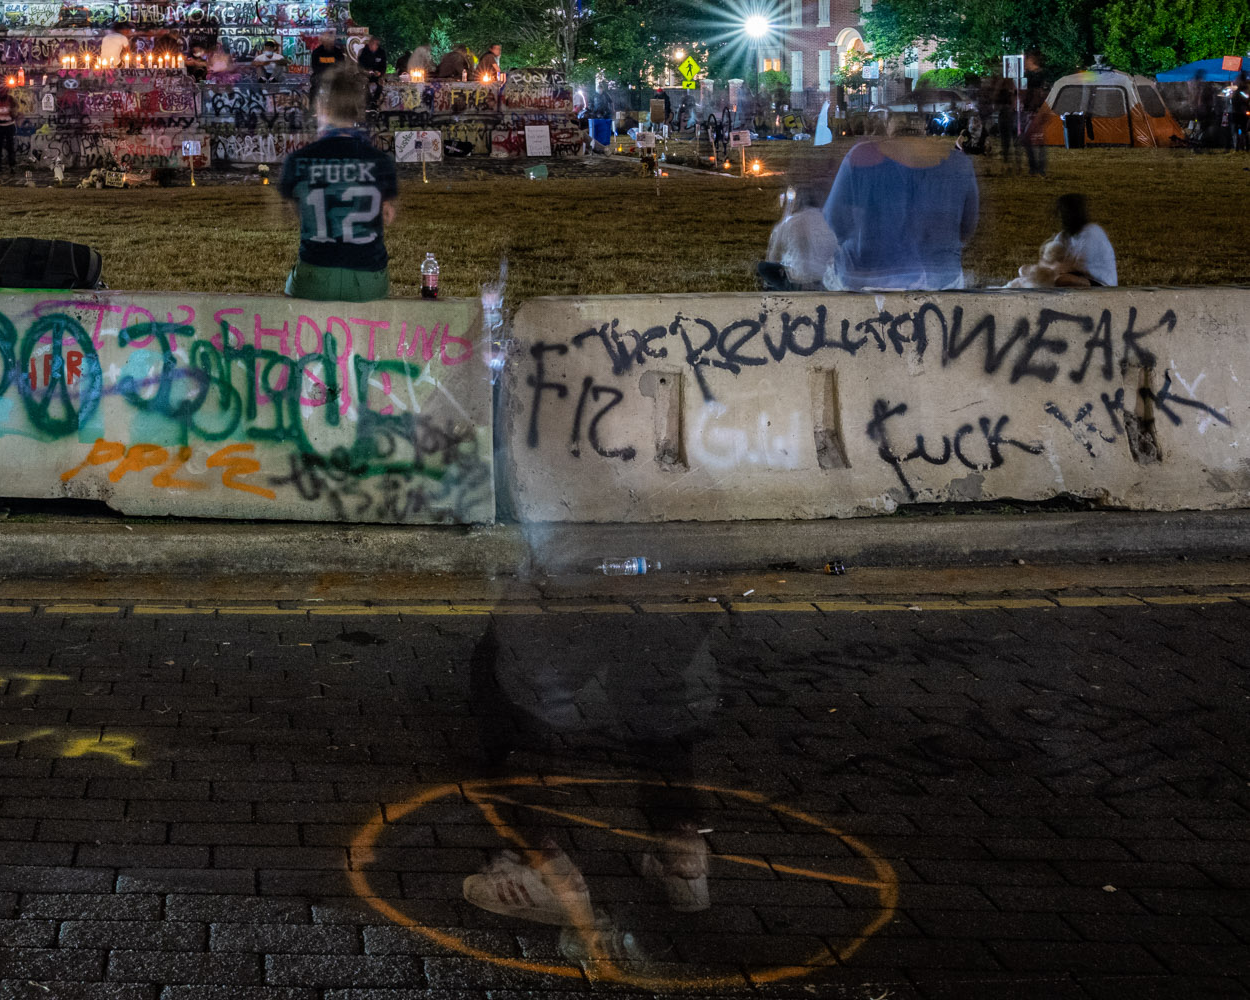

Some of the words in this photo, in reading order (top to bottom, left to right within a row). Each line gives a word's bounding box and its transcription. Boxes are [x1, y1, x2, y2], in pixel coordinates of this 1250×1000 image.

[511, 73, 549, 85] FUCK
[451, 88, 488, 106] FTP
[309, 162, 376, 185] FUCK
[306, 186, 382, 245] 12
[950, 305, 1177, 384] WEAK
